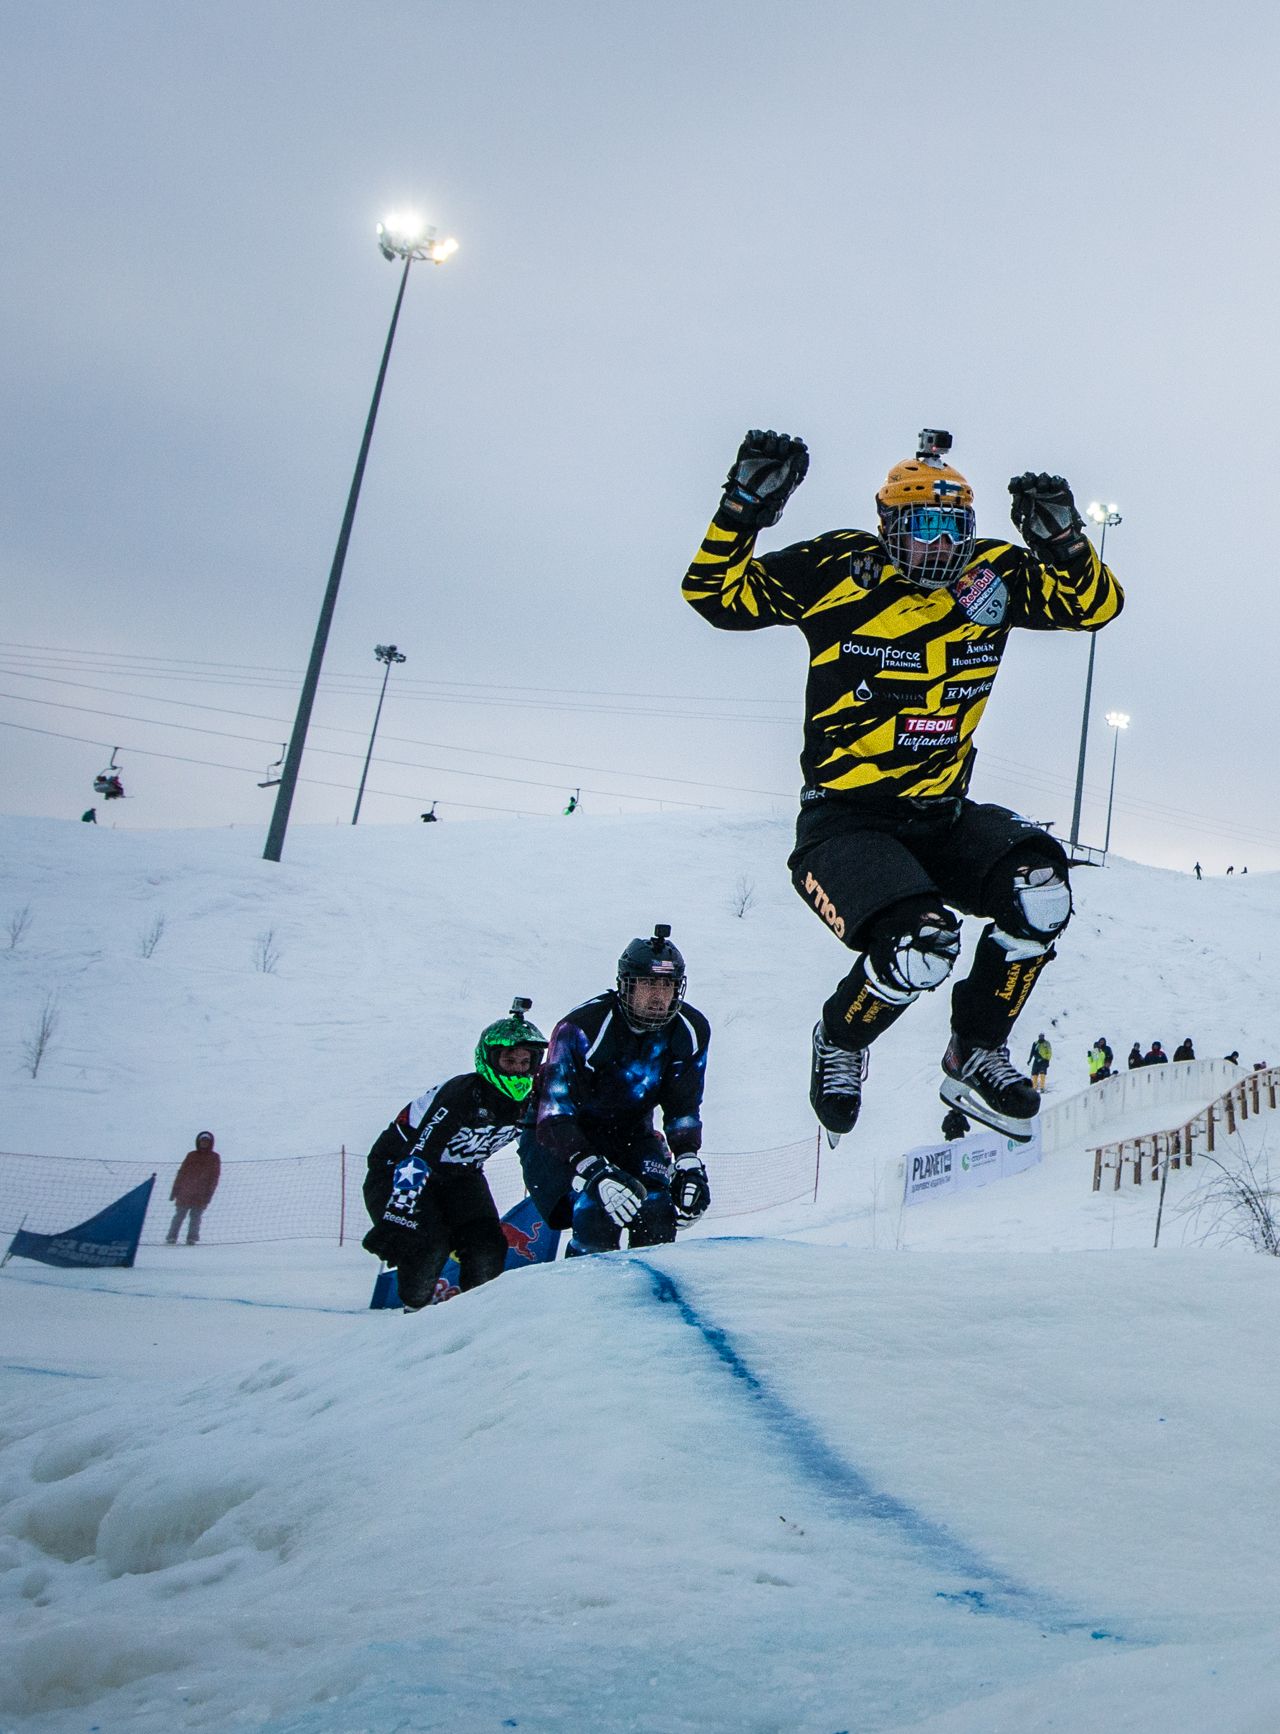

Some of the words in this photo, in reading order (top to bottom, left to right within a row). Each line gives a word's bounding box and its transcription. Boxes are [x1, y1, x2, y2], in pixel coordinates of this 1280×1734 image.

[959, 586, 982, 609] Red
[974, 568, 996, 592] Bull
[985, 599, 1003, 619] 59
[842, 641, 921, 669] downforce
[885, 660, 922, 669] TRAINING
[957, 681, 993, 700] Marke
[908, 719, 954, 732] TEBOIL
[804, 871, 846, 938] GOLLA
[383, 1210, 418, 1230] Reebok
